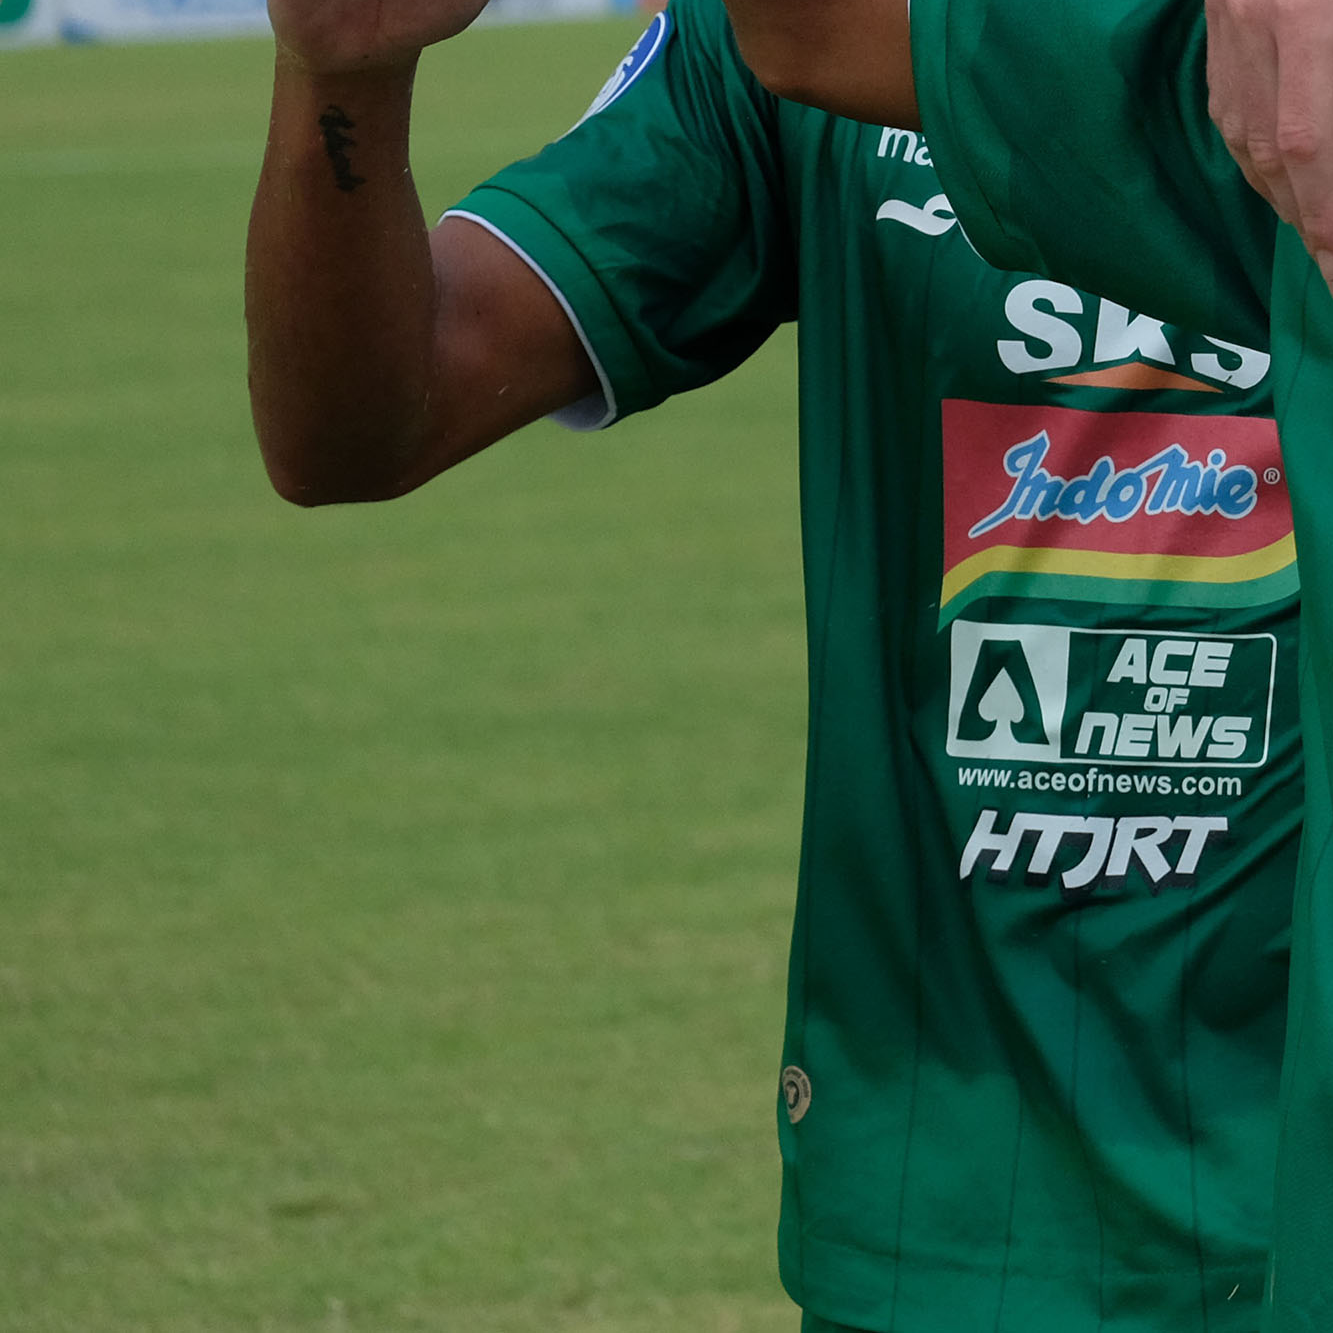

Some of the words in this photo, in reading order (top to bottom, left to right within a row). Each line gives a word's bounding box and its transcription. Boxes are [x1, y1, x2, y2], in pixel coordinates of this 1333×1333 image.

[1106, 638, 1234, 688] ACE
[1143, 686, 1190, 713] OF
[1074, 712, 1253, 759] NEWS
[957, 765, 1243, 797] www.aceofnews.com
[958, 808, 1230, 890] HTJRT
